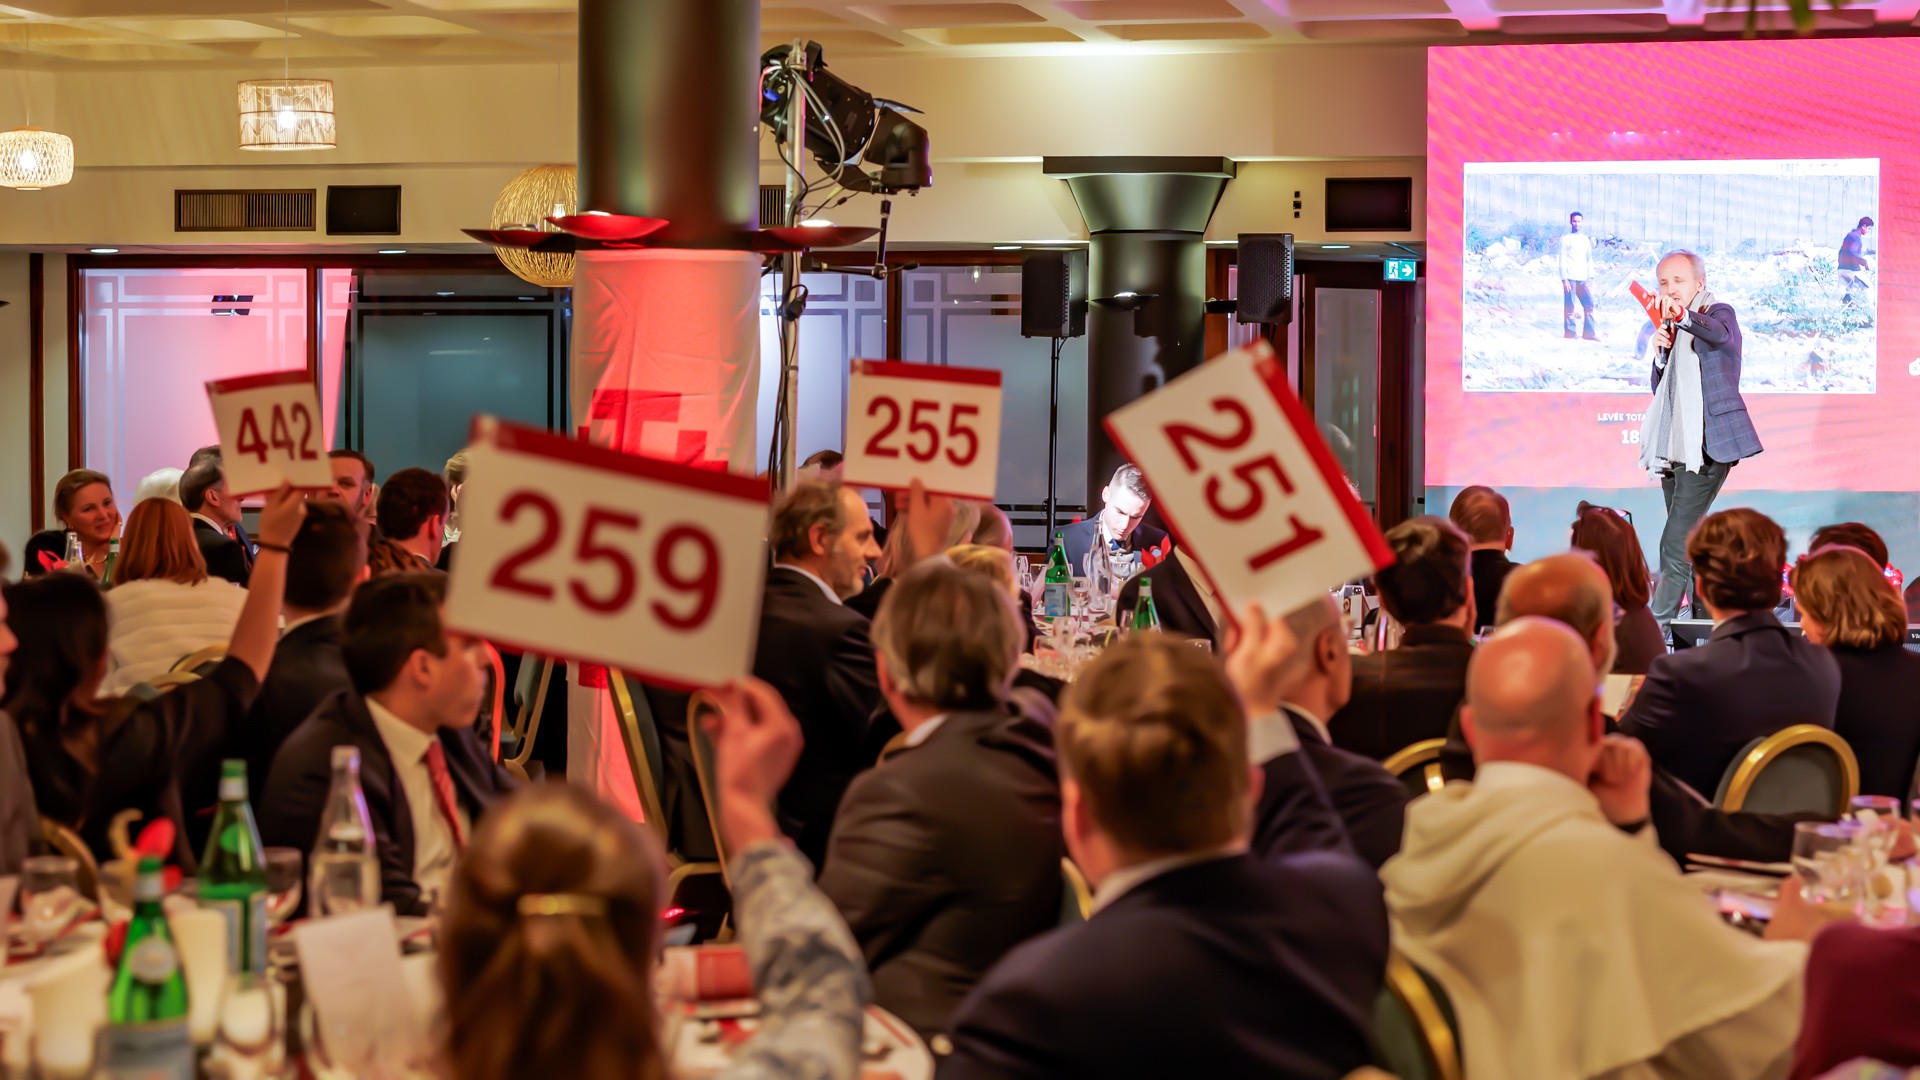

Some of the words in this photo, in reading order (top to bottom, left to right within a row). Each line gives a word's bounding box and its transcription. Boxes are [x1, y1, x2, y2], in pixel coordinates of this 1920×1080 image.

[235, 401, 320, 465] 442
[863, 394, 981, 468] 255
[1597, 412, 1624, 422] LEVÉE
[1161, 396, 1326, 575] 251
[486, 487, 725, 636] 259
